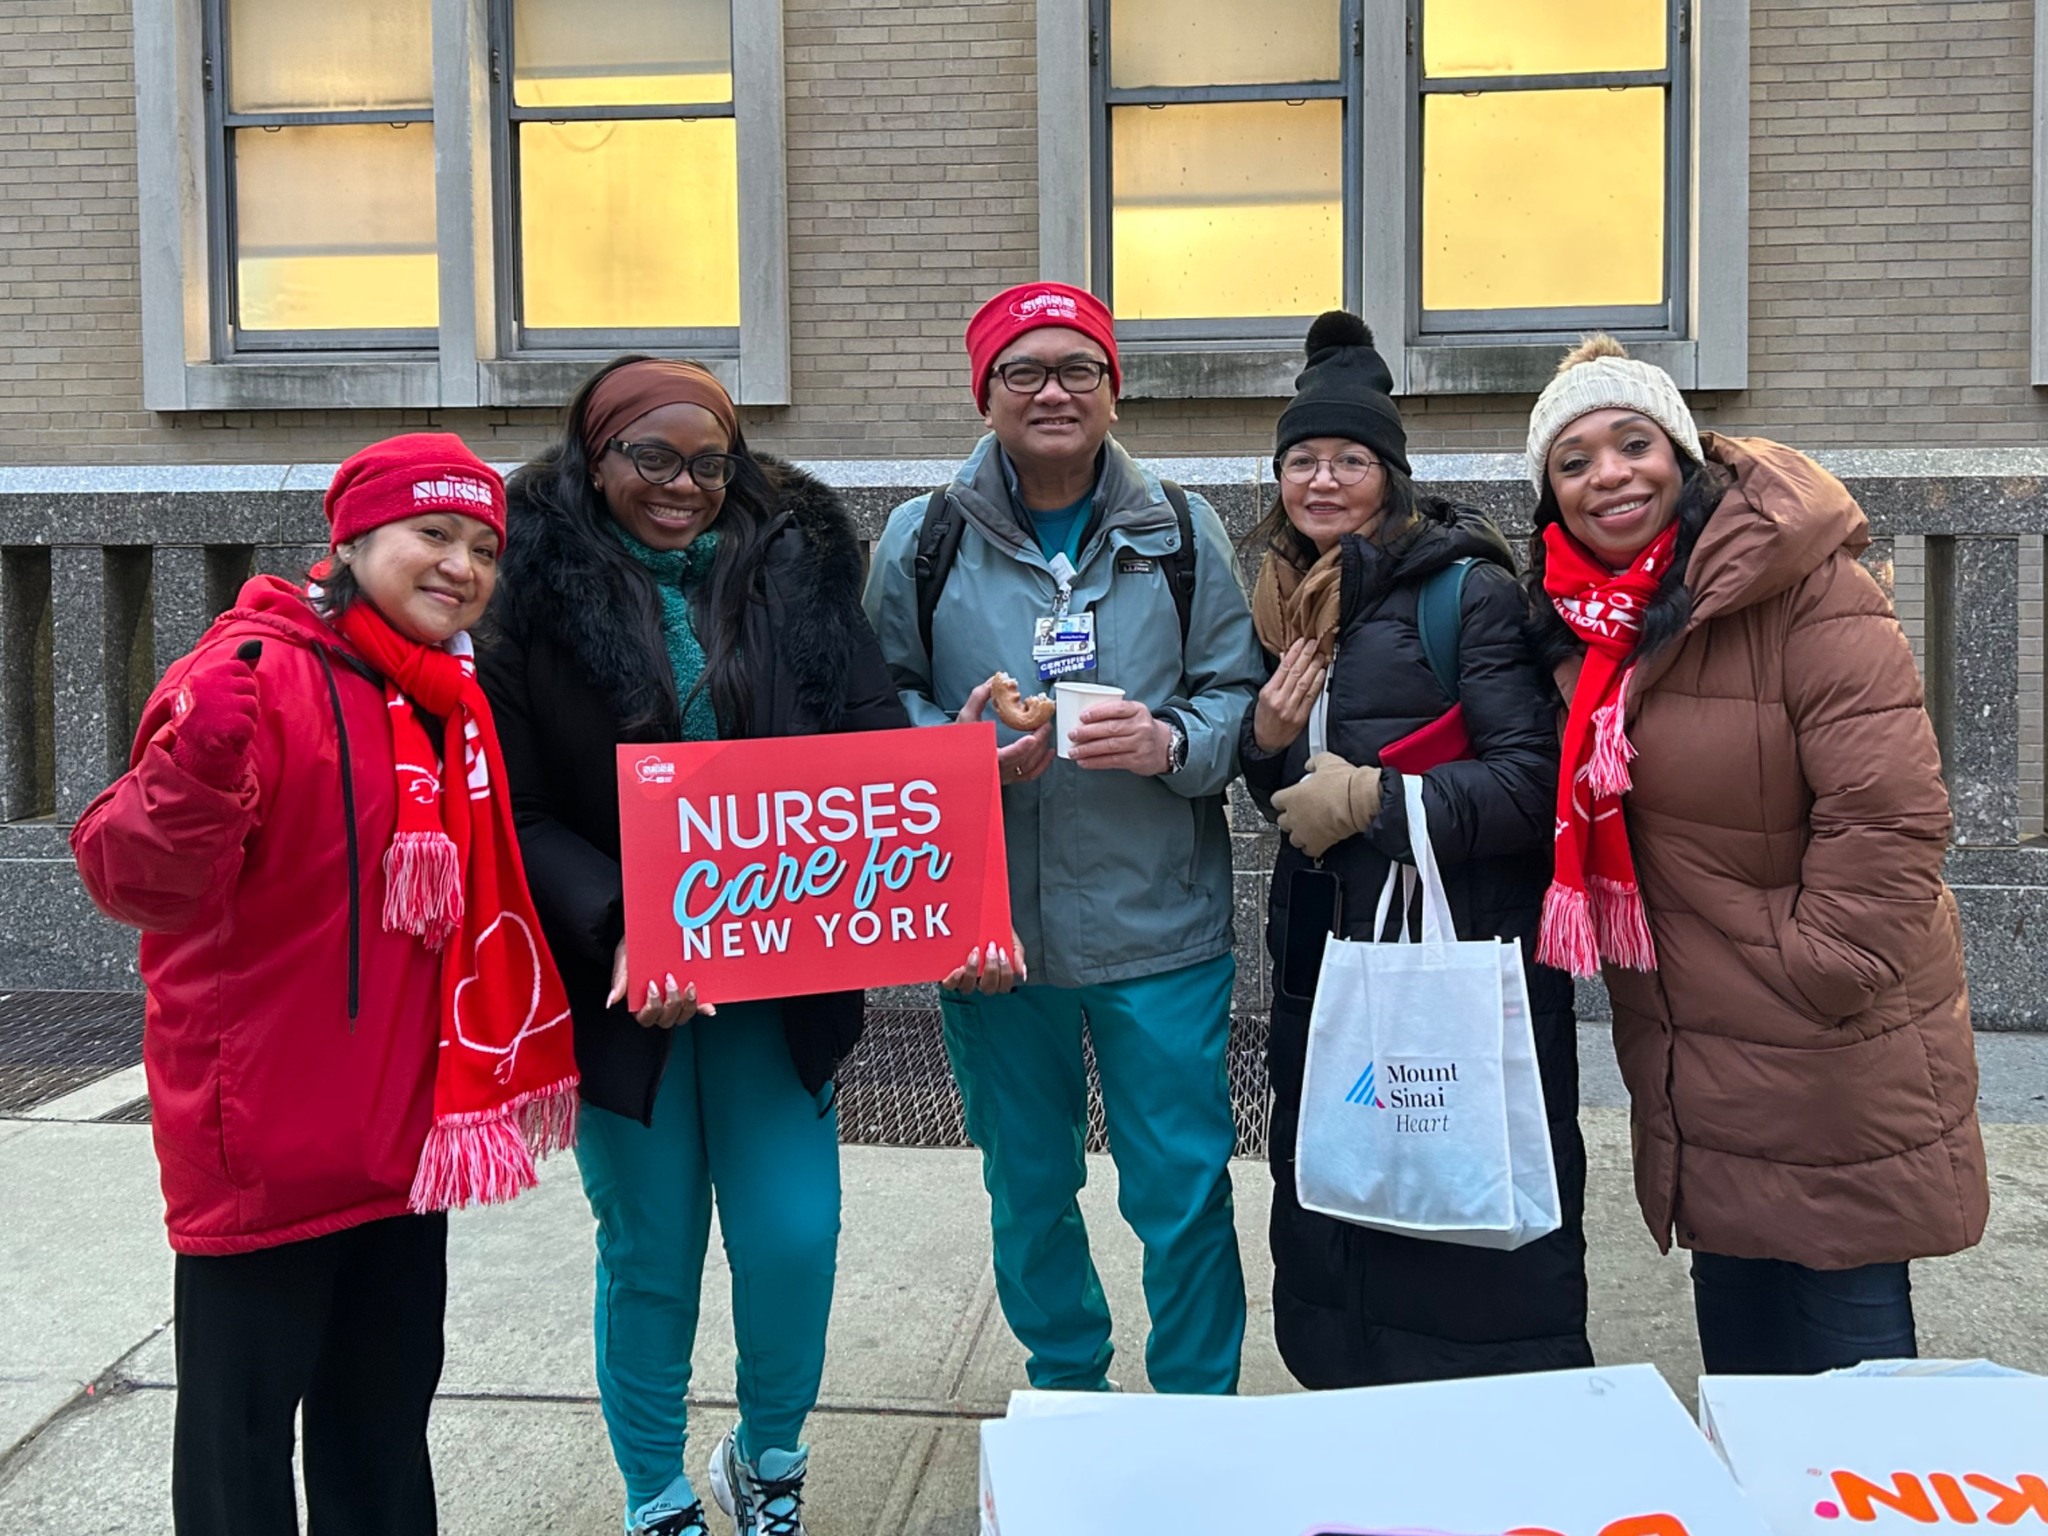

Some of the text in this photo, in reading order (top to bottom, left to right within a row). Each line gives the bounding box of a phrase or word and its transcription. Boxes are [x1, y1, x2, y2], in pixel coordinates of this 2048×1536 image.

[412, 480, 493, 507] NURSES
[1040, 653, 1094, 672] CERTIFIED
[1049, 662, 1085, 676] NURSE
[677, 780, 941, 853] NURSES
[673, 834, 953, 930] Care for
[682, 902, 953, 961] NEW YORK
[1386, 1062, 1460, 1084] Mount
[1390, 1086, 1446, 1109] Sinai
[1396, 1113, 1450, 1133] Heart
